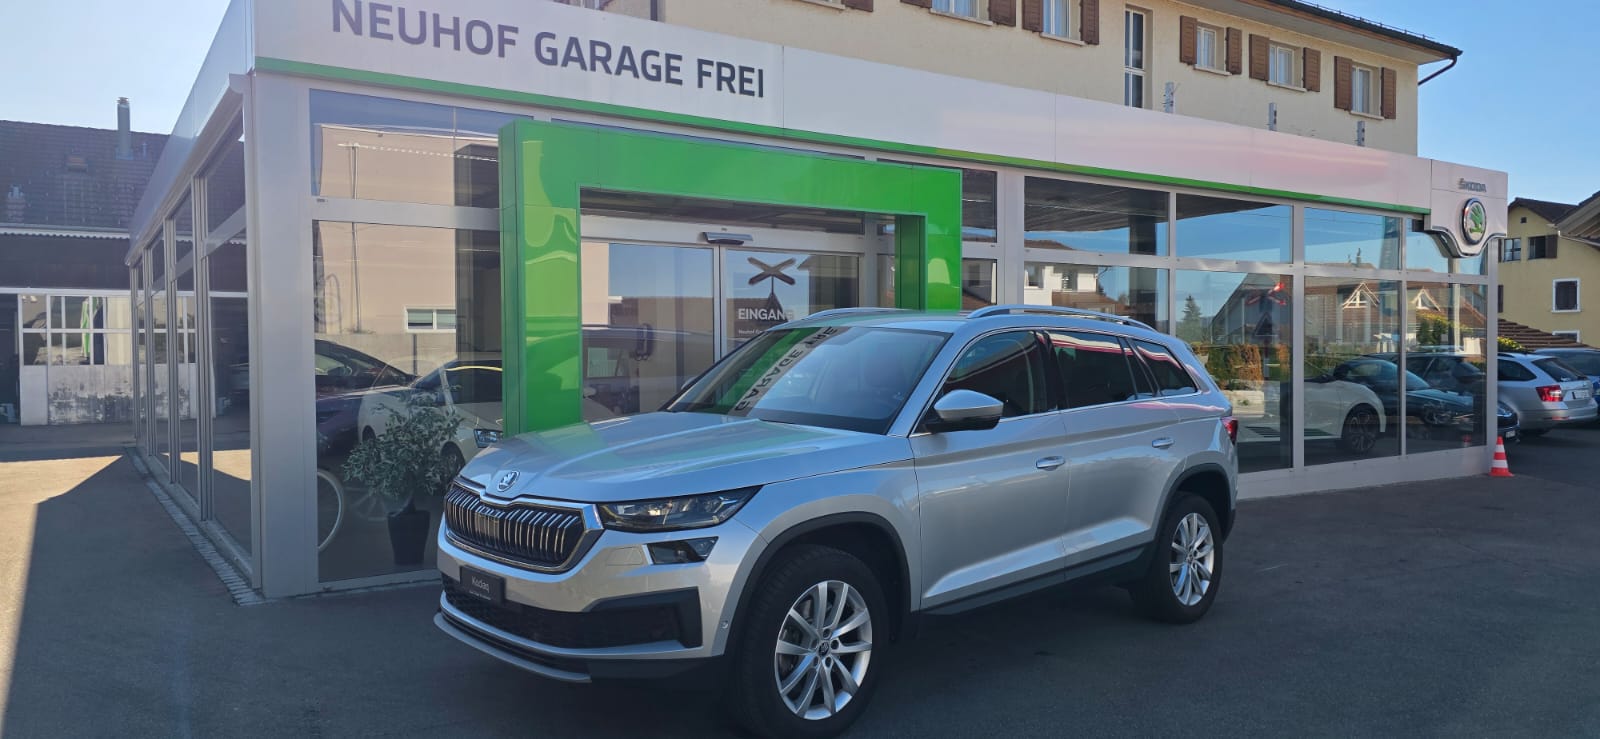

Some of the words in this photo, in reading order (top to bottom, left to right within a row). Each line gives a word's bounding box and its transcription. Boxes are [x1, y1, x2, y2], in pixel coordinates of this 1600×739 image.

[332, 0, 519, 58] NEUHOF
[534, 31, 683, 86] GARAGE
[697, 58, 764, 98] FREI
